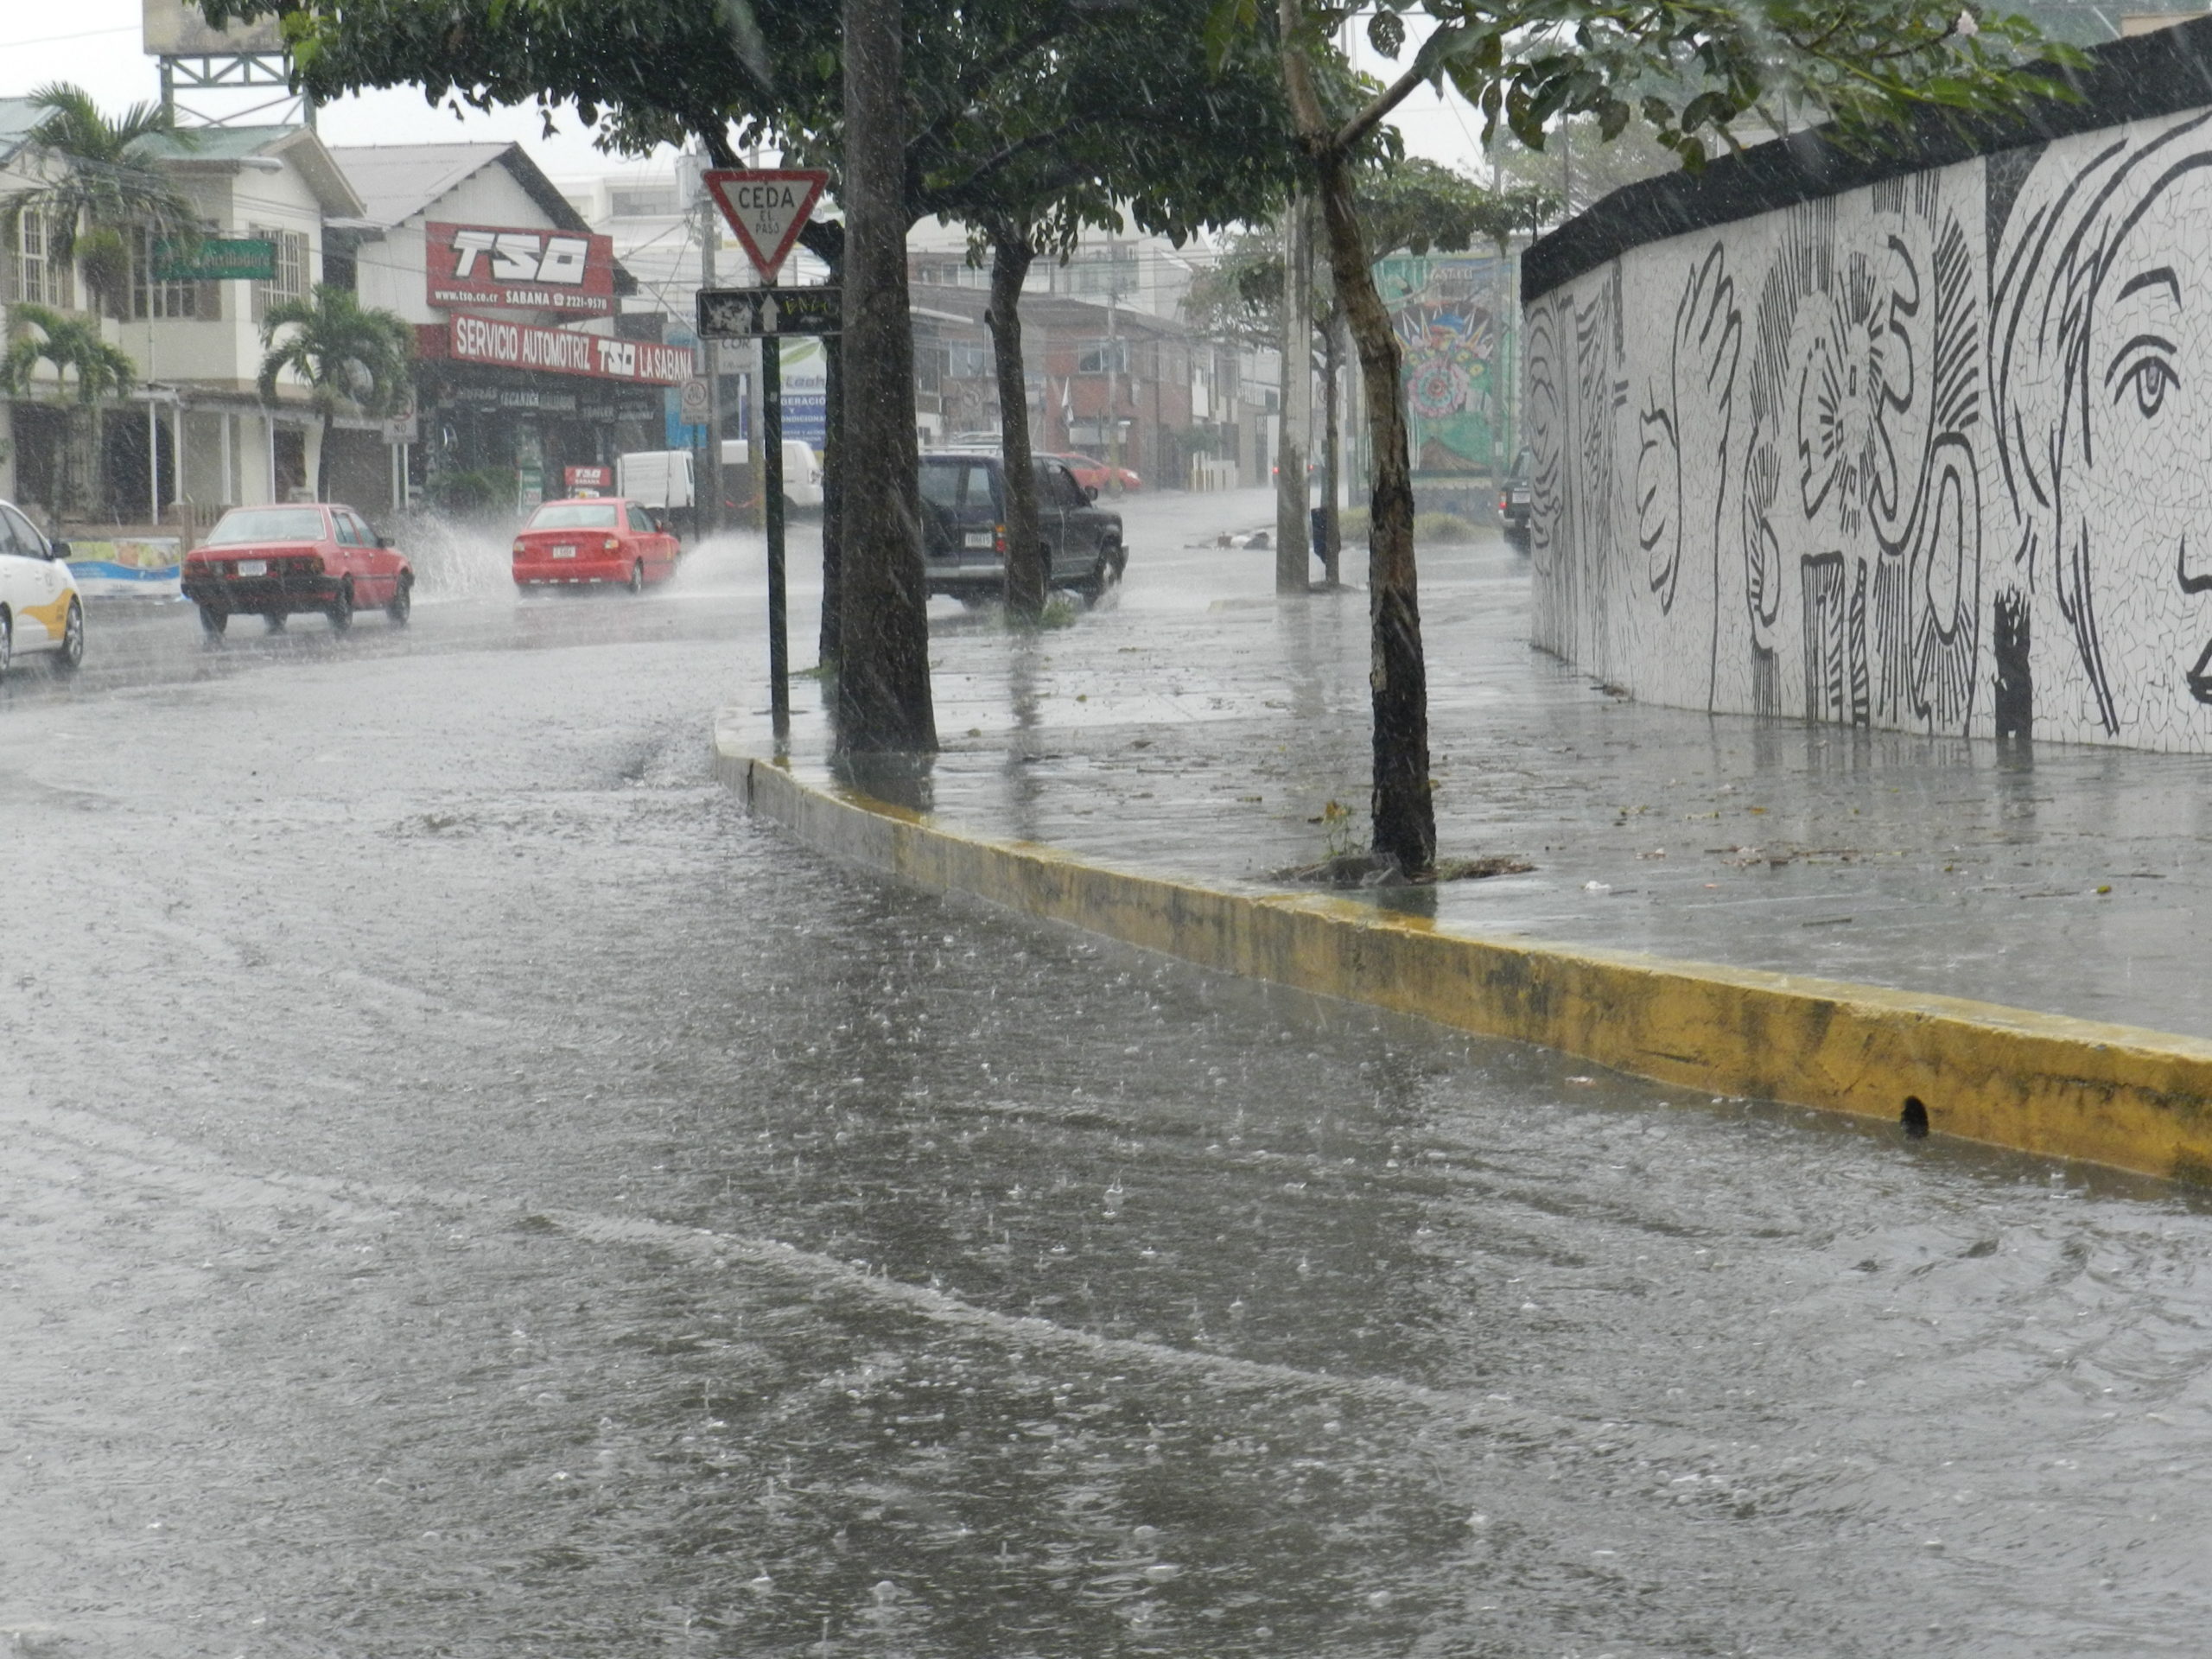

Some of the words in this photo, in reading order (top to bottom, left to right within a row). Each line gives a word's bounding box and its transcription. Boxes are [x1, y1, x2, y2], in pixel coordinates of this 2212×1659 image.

[739, 186, 795, 208] CEDA
[760, 210, 773, 222] EL
[756, 221, 779, 234] PASO
[451, 230, 589, 284] TSO
[435, 290, 499, 302] www.tso.co.cr
[505, 289, 550, 307] SABANA
[456, 316, 518, 362] SERVICIO
[523, 328, 591, 371] AUTOMOTRIZ
[598, 340, 636, 377] TSO
[639, 347, 654, 375] LA
[654, 347, 693, 381] SABANA
[575, 467, 601, 478] TSO
